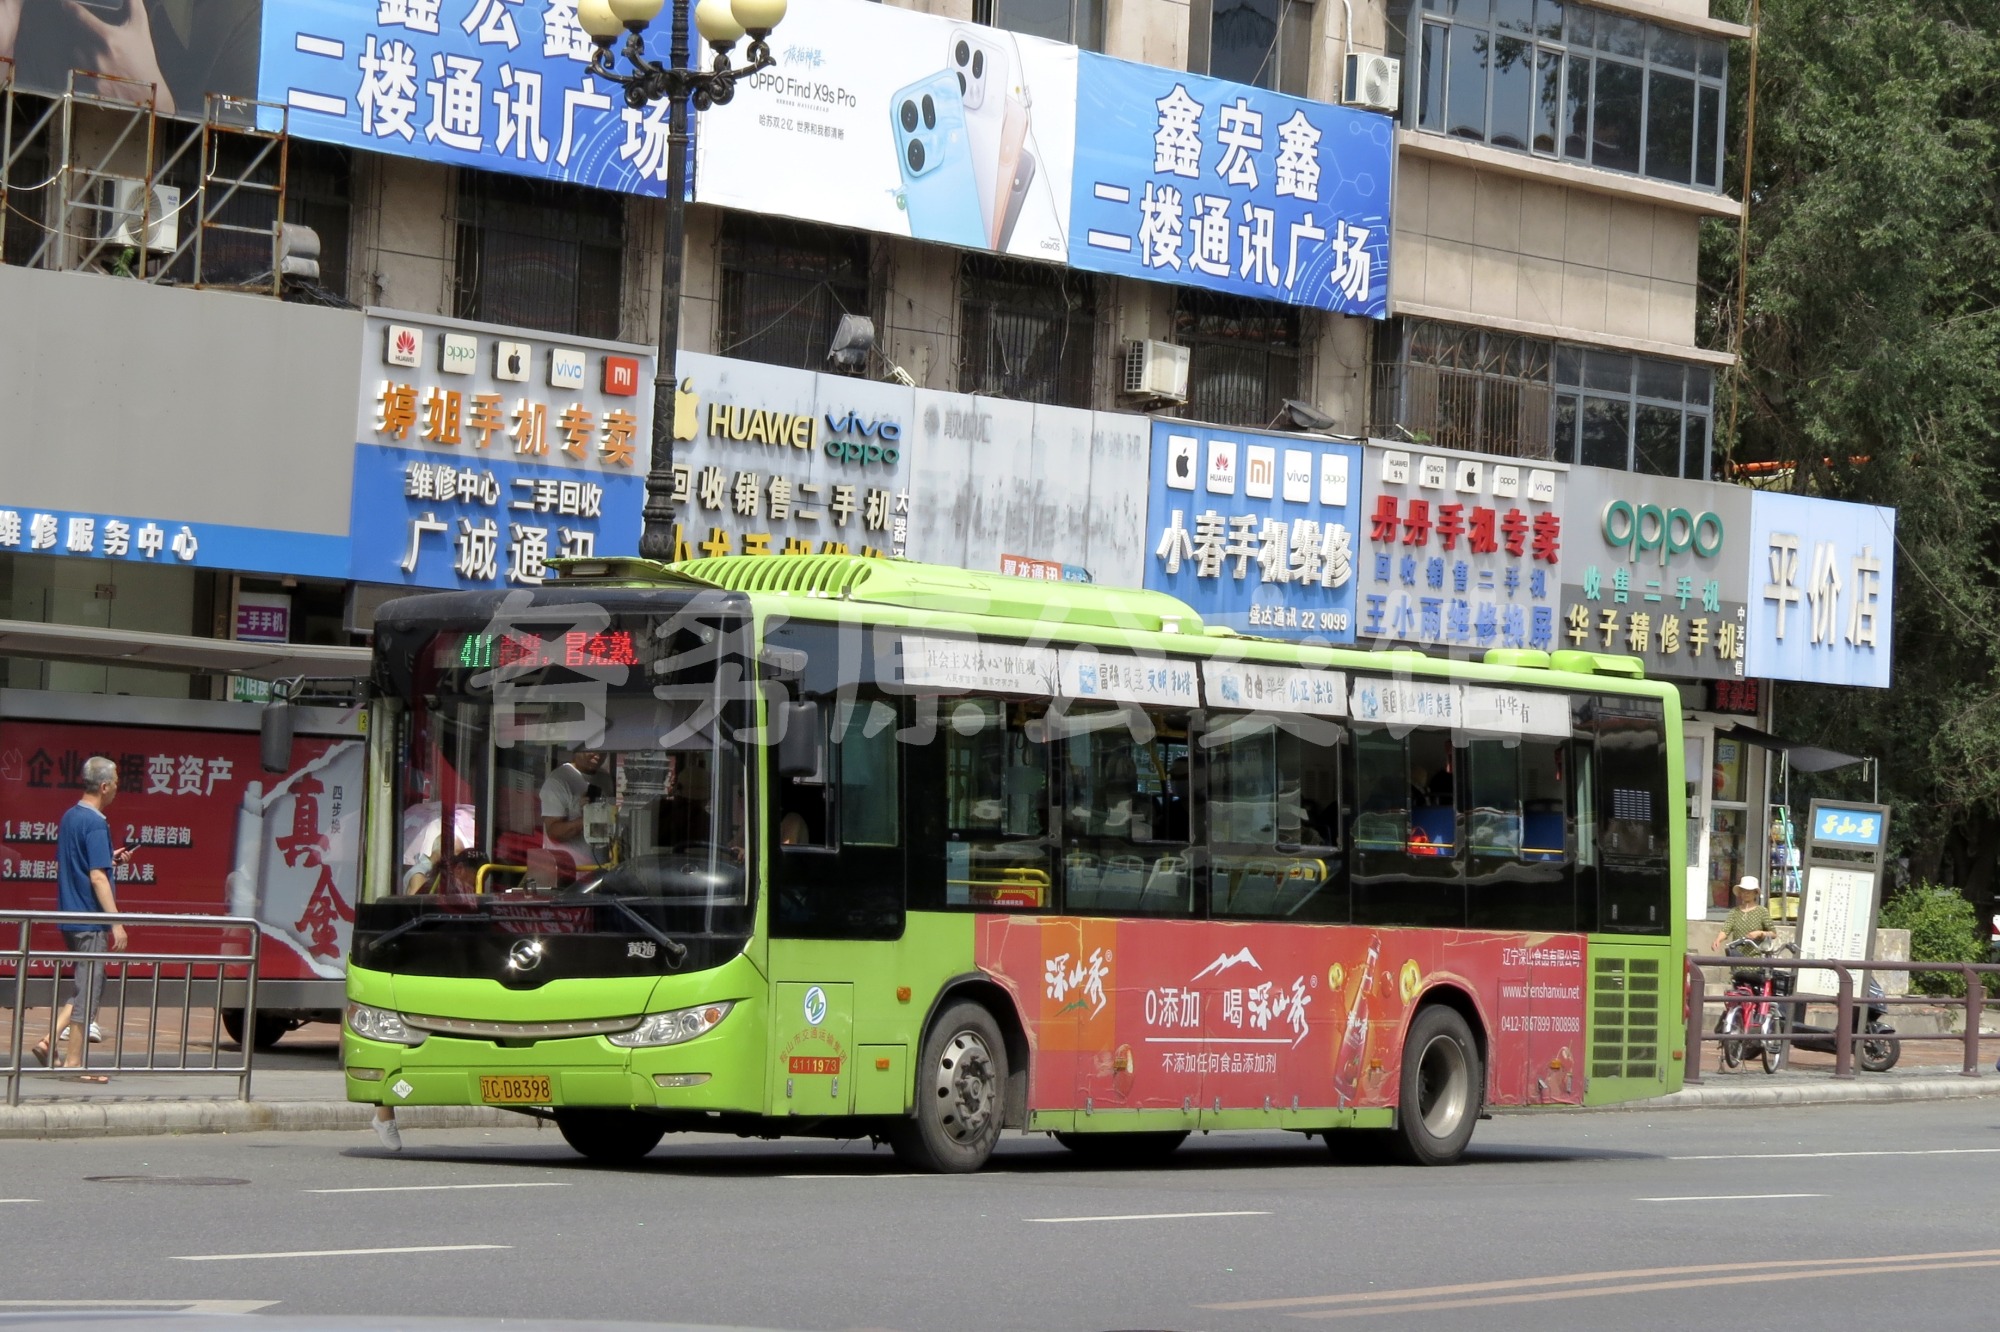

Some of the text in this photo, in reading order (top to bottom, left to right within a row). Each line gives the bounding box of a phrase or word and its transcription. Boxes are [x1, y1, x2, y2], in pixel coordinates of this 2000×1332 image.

[749, 71, 857, 108] OPPO Find X9s Pro
[287, 32, 670, 183] 二楼通讯广场
[1153, 82, 1323, 203] 鑫宏鑫
[1087, 181, 1372, 303] 二楼通讯广场
[395, 355, 415, 364] HUAWEI
[556, 358, 583, 380] vivo
[376, 379, 638, 467] 婷姐手机专卖
[707, 402, 817, 450] HUAWEI
[825, 411, 902, 440] vivo
[1209, 473, 1234, 484] HUAWEI
[1286, 470, 1310, 483] vivo
[1389, 459, 1409, 468] HUAWEI
[1426, 464, 1444, 473] HONOR
[405, 462, 603, 518] 维修中心 二手回收
[672, 463, 893, 531] 回收销售二手机
[1535, 481, 1553, 493] vivo
[0, 510, 198, 561] 维修服务中心
[1371, 495, 1560, 564] 丹丹手机专卖
[401, 511, 595, 585] 广诚通讯
[1156, 509, 1353, 588] 小春手机维修
[1374, 552, 1547, 599] 回收销售二手机
[1584, 566, 1720, 613] 收售二手机
[1763, 532, 1882, 648] 平价店
[237, 611, 284, 632] 二手手机
[1301, 611, 1315, 629] 22
[1320, 612, 1347, 631] 9099
[1565, 603, 1737, 660] 华子精修手机
[460, 634, 492, 667] 411
[926, 649, 1037, 676] 社会主义核心价值观
[1147, 668, 1169, 696] 文明
[1244, 672, 1263, 700] 自由
[1289, 679, 1310, 703] 公正
[1312, 679, 1334, 705] 法治
[26, 747, 234, 797] 企业据变资产
[331, 785, 343, 834] 四步换
[112, 862, 155, 881] 据入表
[276, 772, 355, 959] 真金
[628, 942, 656, 957] 黄海
[1502, 948, 1581, 968] 辽宁深山食品有限公司
[1145, 987, 1200, 1028] 0添加
[1502, 982, 1580, 999] www.shenshanxiu.net
[1162, 1053, 1277, 1073] 不添加任何食品添加剂
[395, 1083, 410, 1095] LNG
